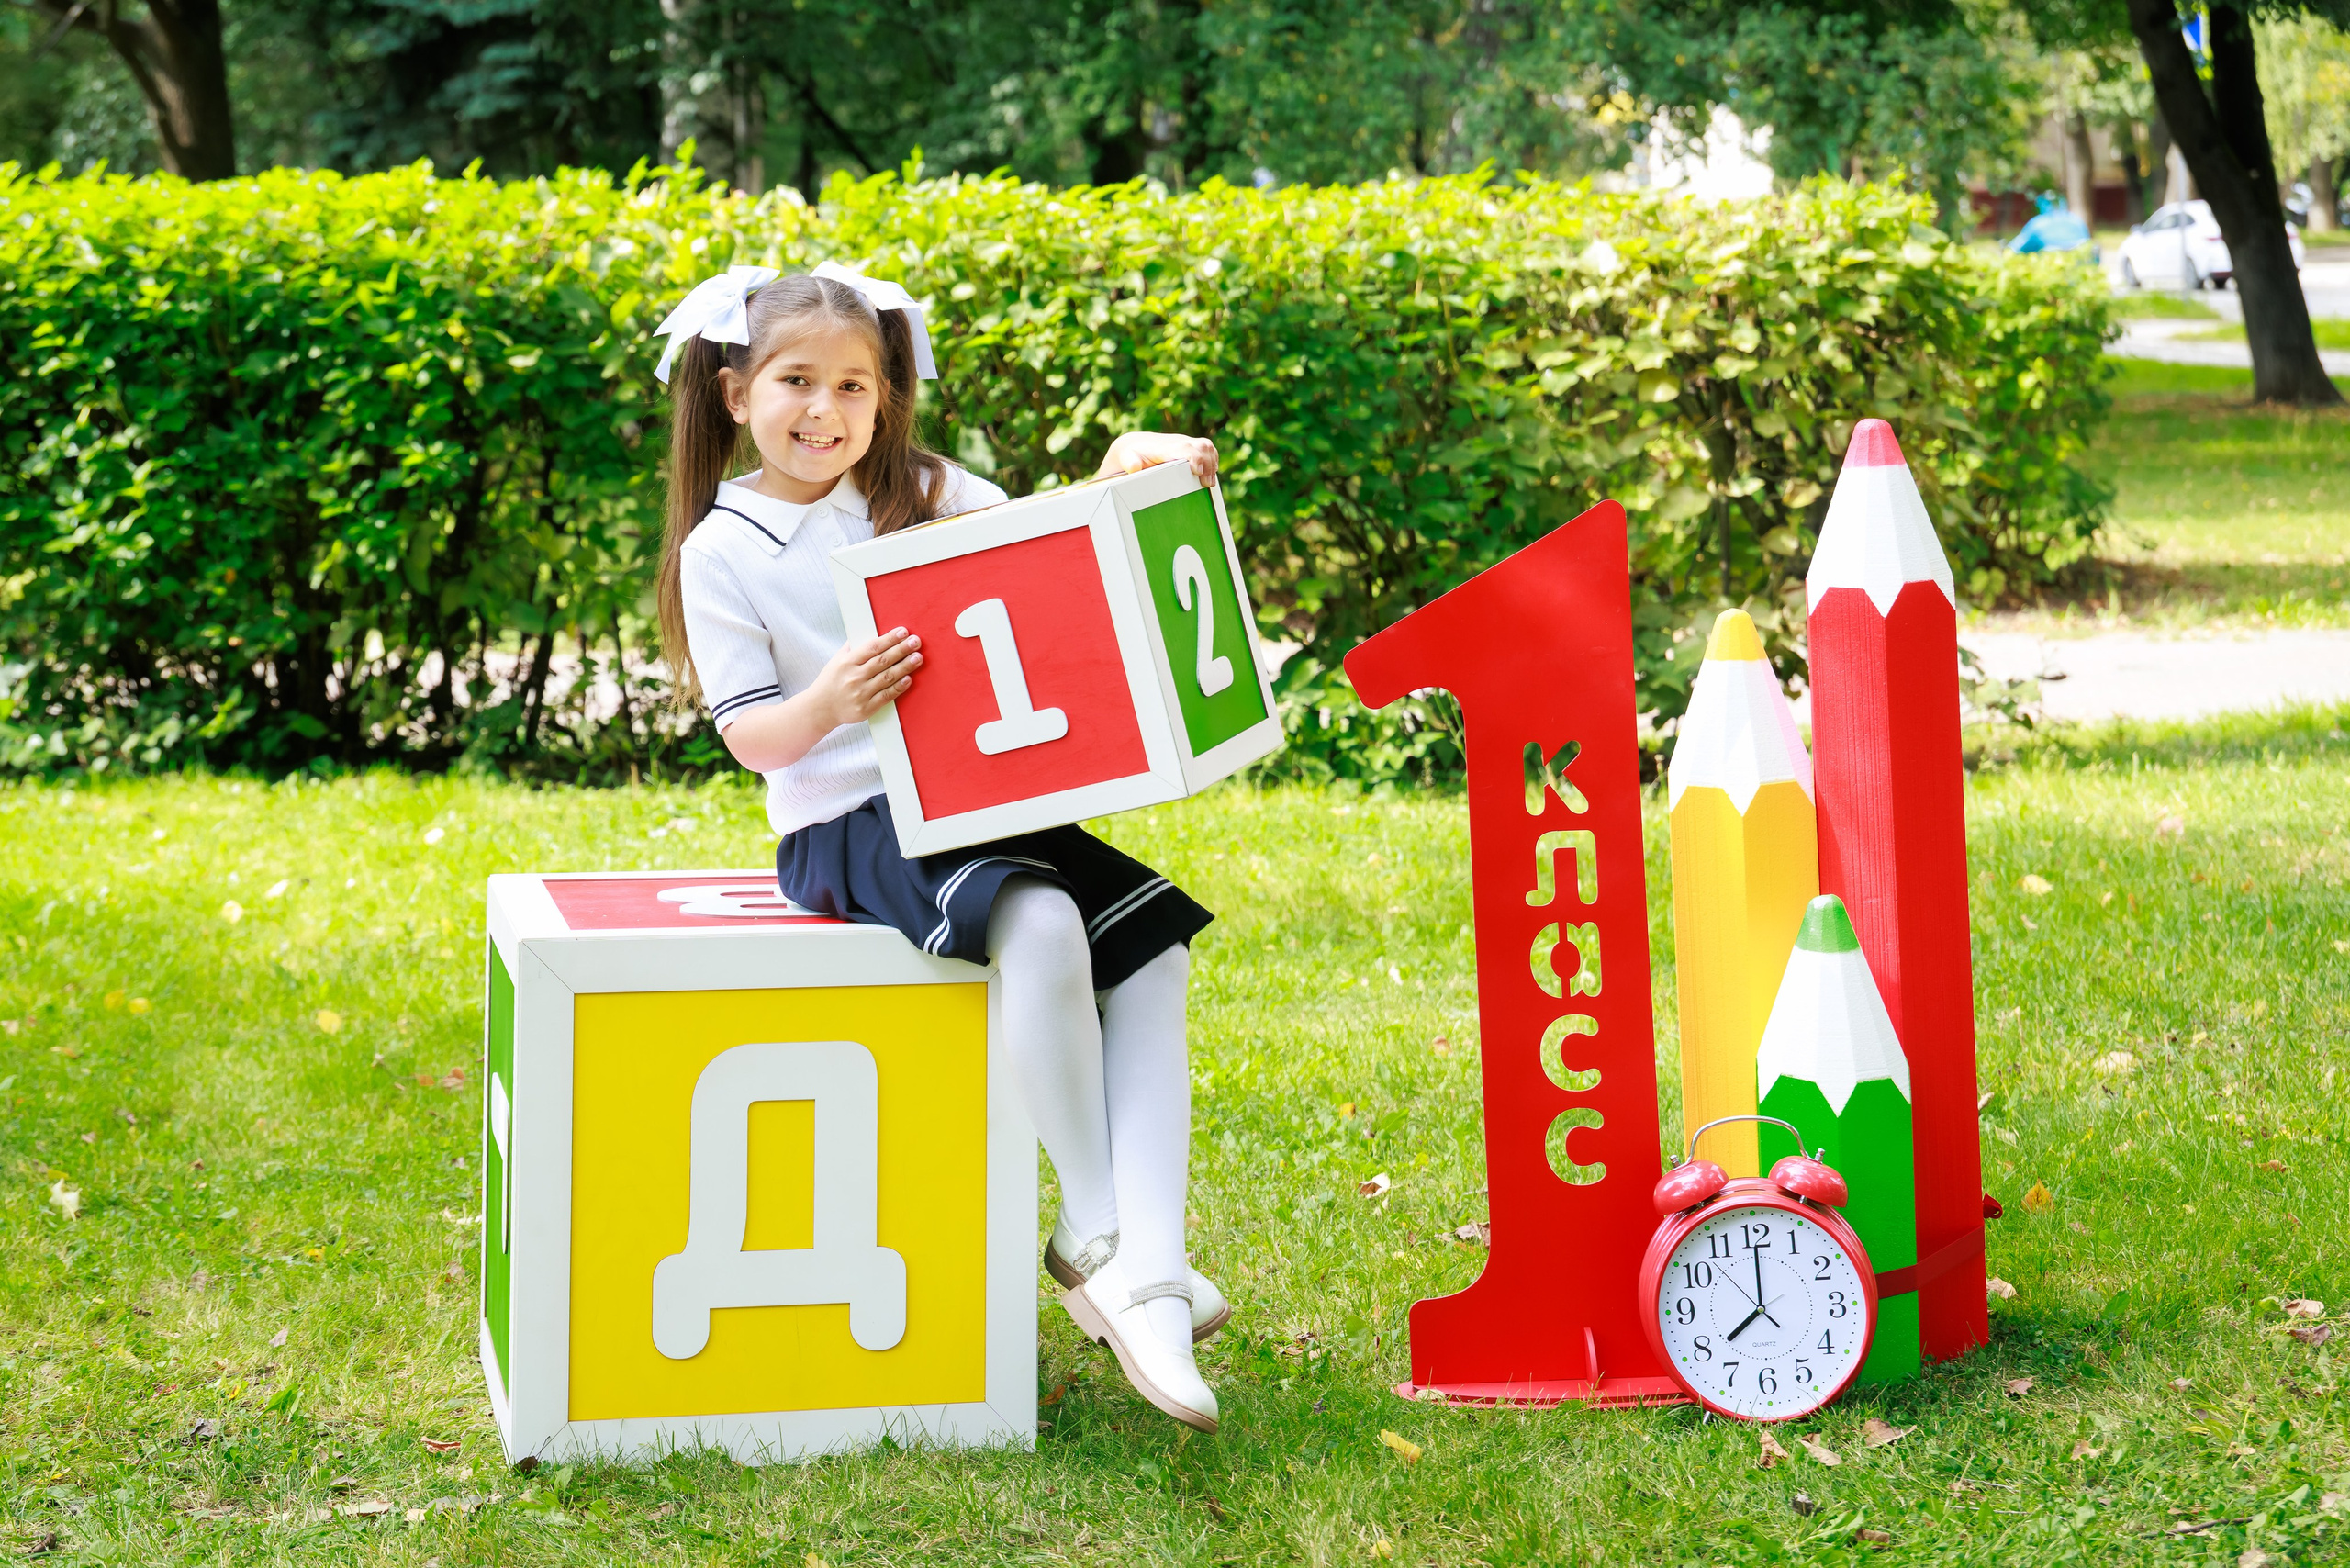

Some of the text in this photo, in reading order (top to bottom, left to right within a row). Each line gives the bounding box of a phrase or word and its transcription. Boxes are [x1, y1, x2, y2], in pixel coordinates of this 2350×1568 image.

[1172, 544, 1234, 698] 2
[955, 598, 1069, 756] 1
[1343, 498, 1671, 1384] 1
[652, 1040, 907, 1360] Д
[1707, 1233, 1733, 1259] 11
[1740, 1223, 1771, 1249] 12
[1787, 1229, 1800, 1255] 1
[1683, 1261, 1712, 1289] 10
[1813, 1256, 1832, 1281] 2
[1676, 1297, 1695, 1325] 9
[1828, 1291, 1847, 1319] 3
[1694, 1335, 1712, 1362] 8
[1817, 1328, 1835, 1355] 4
[1723, 1361, 1740, 1387] 7
[1758, 1368, 1777, 1395] 6
[1796, 1358, 1813, 1384] 5
